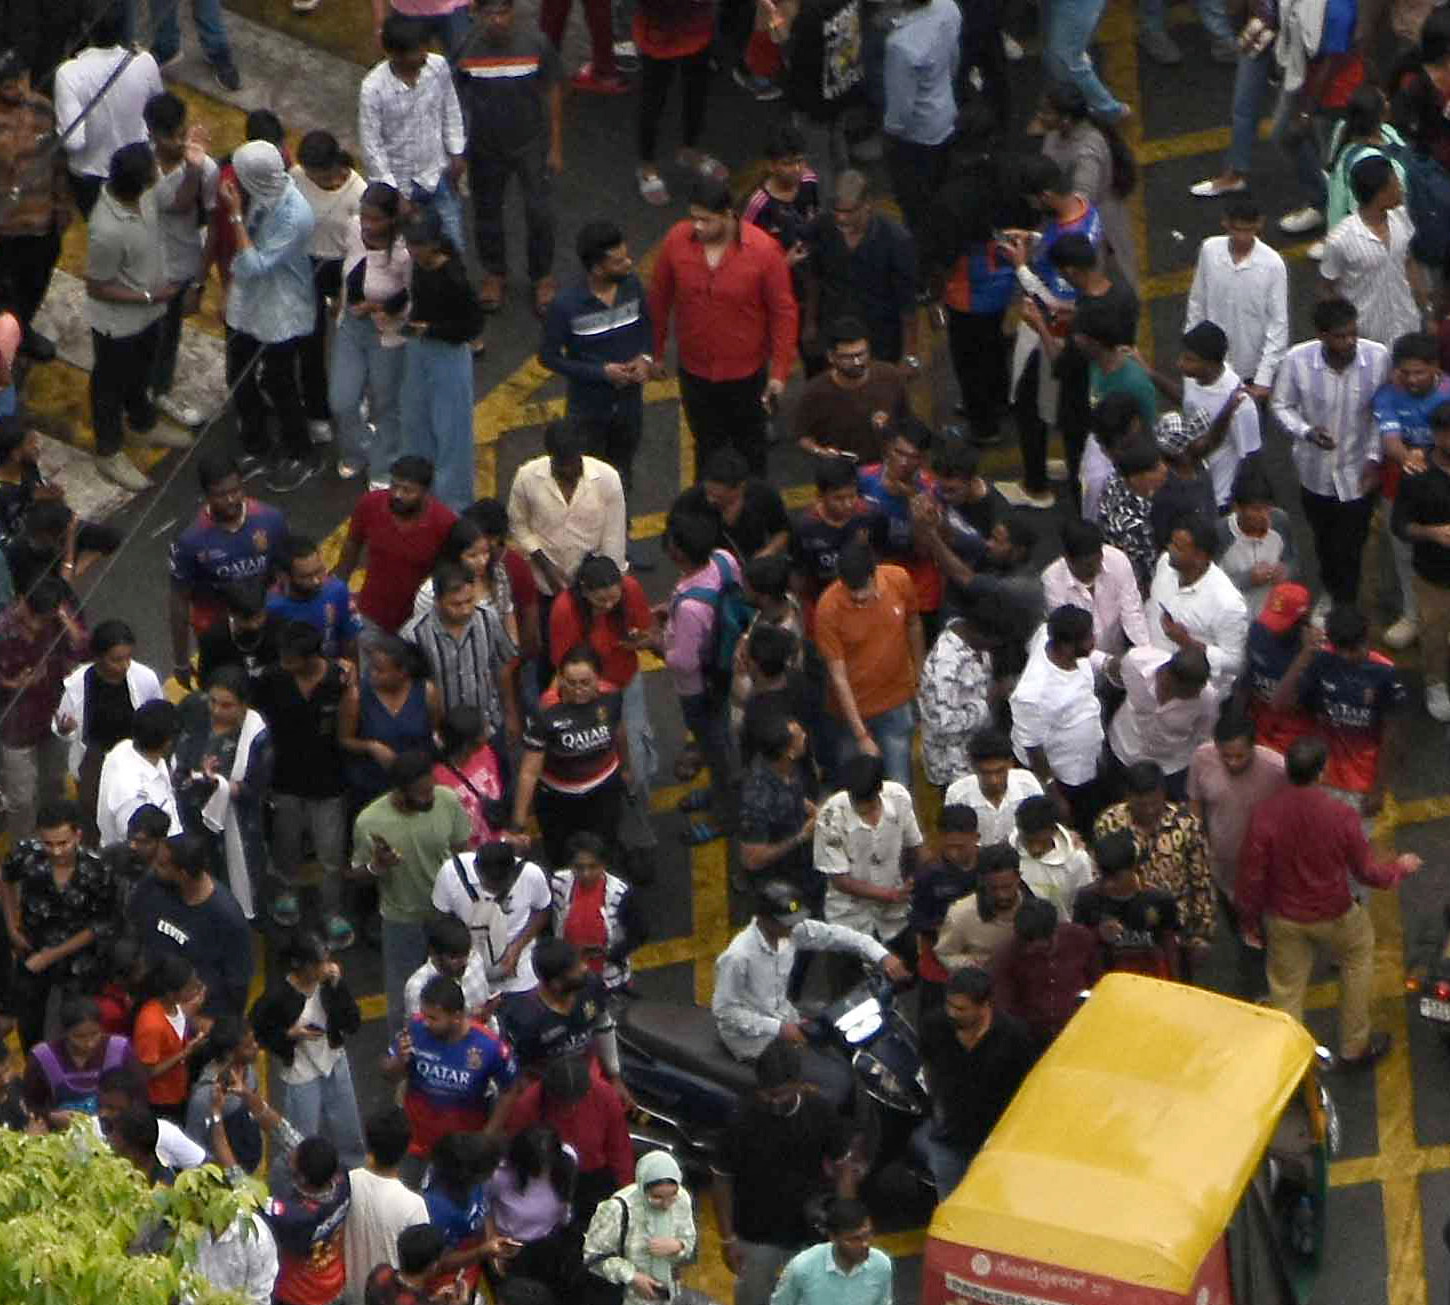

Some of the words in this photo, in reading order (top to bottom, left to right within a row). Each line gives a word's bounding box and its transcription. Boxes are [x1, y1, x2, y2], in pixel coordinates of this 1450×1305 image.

[217, 556, 267, 578] QATAR
[562, 725, 610, 750] QATAR
[416, 1061, 470, 1085] QATAR
